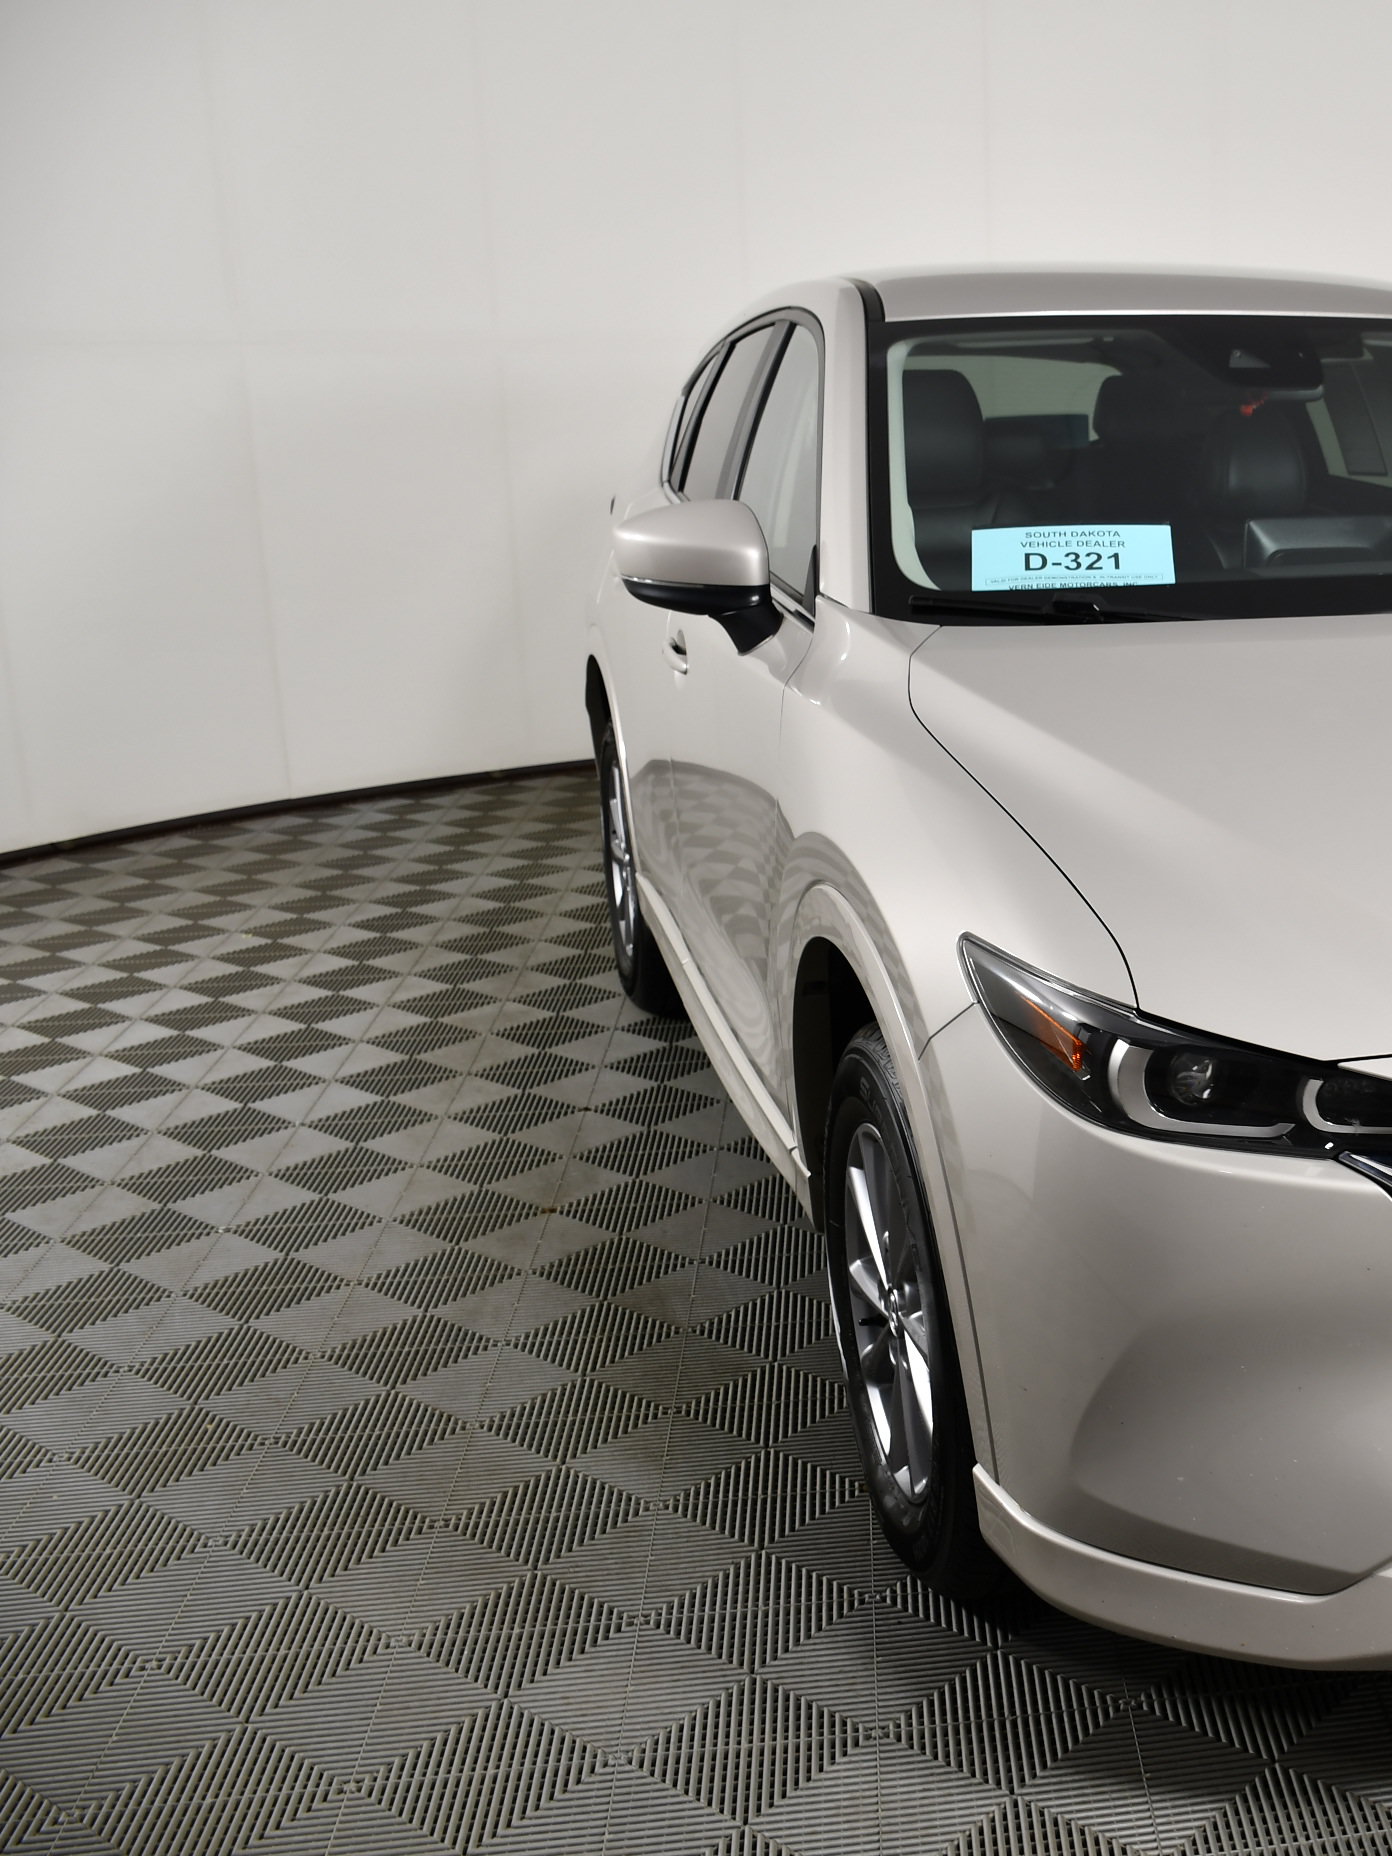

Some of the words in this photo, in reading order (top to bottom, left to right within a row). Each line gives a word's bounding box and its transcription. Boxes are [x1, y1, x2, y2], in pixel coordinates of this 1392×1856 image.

[1071, 530, 1120, 538] DAKOTA
[1020, 540, 1072, 548] VEHICLE
[1076, 540, 1125, 548] DEALER
[1024, 551, 1120, 571] D-321
